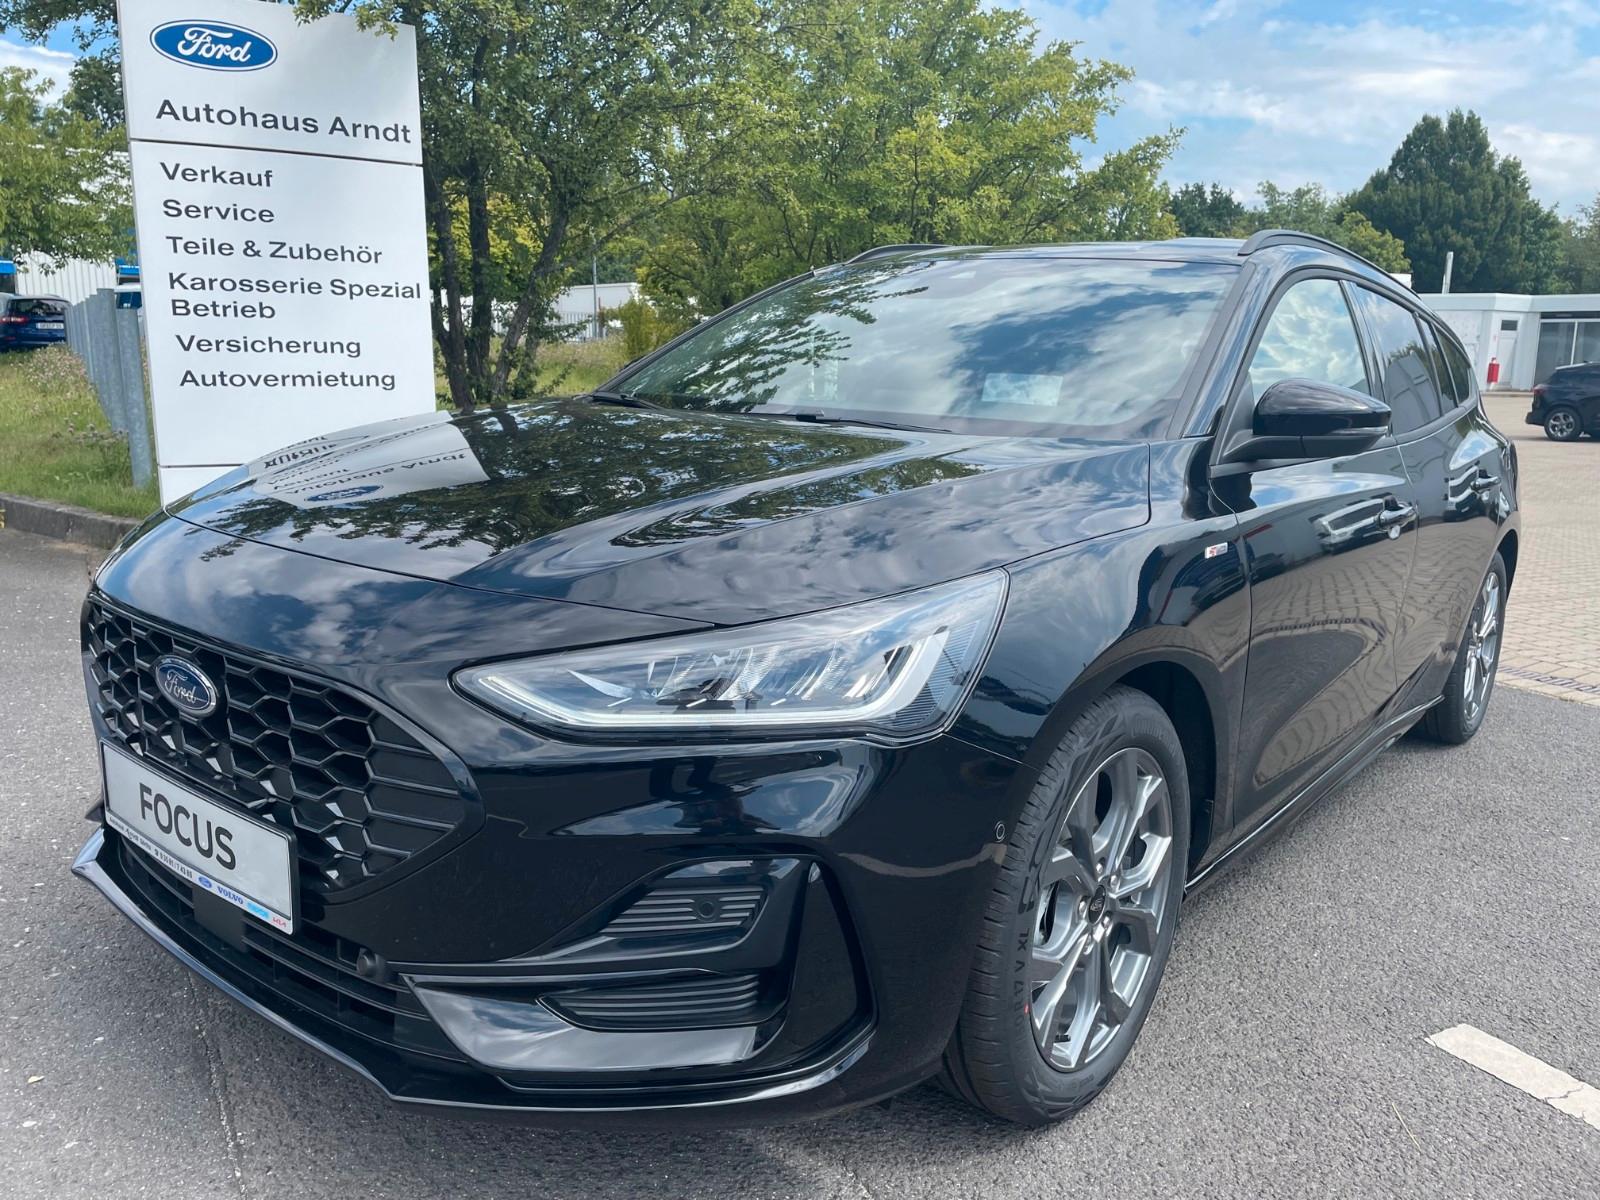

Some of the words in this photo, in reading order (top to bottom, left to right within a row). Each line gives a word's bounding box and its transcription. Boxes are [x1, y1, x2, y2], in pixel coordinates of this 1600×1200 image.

[177, 26, 251, 62] Ford
[155, 99, 319, 133] Autohaus
[328, 116, 411, 144] Arndt
[160, 162, 273, 187] Verkauf
[163, 199, 275, 223] Service
[165, 236, 234, 257] Teile
[242, 240, 262, 258] &
[268, 241, 383, 264] Zubehör
[168, 272, 323, 295] Karosserie
[330, 279, 421, 300] Spezial
[171, 299, 276, 319] Betrieb
[175, 334, 361, 358] Versicherung
[179, 370, 396, 391] Autovermietung
[139, 783, 236, 870] FOCUS
[217, 886, 244, 905] VOLVO
[1017, 928, 1030, 951] XL
